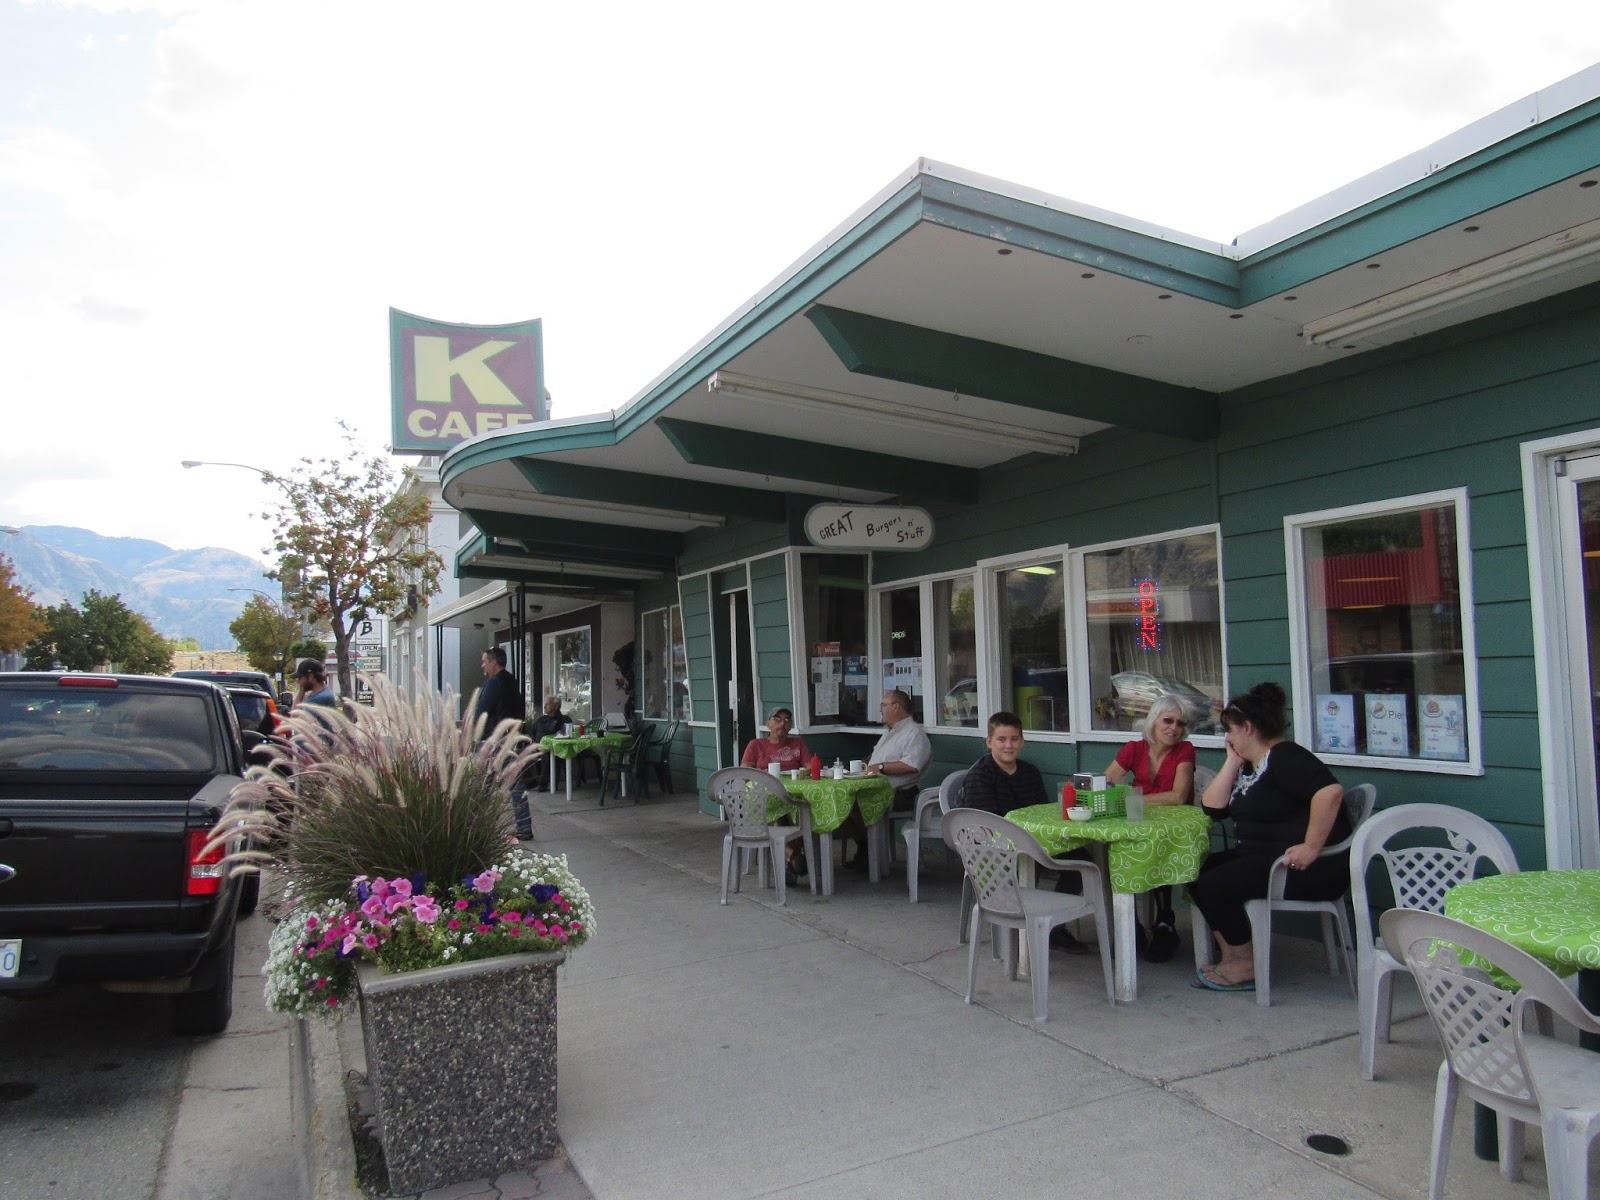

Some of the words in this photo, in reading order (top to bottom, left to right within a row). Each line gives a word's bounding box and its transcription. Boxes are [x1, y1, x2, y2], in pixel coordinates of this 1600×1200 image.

[414, 335, 524, 406] K
[819, 510, 854, 540] GREAT
[866, 516, 902, 537] Burgers
[896, 526, 925, 543] Stuff
[1138, 581, 1157, 648] OPEN
[360, 621, 373, 637] B
[1388, 710, 1402, 720] Pie
